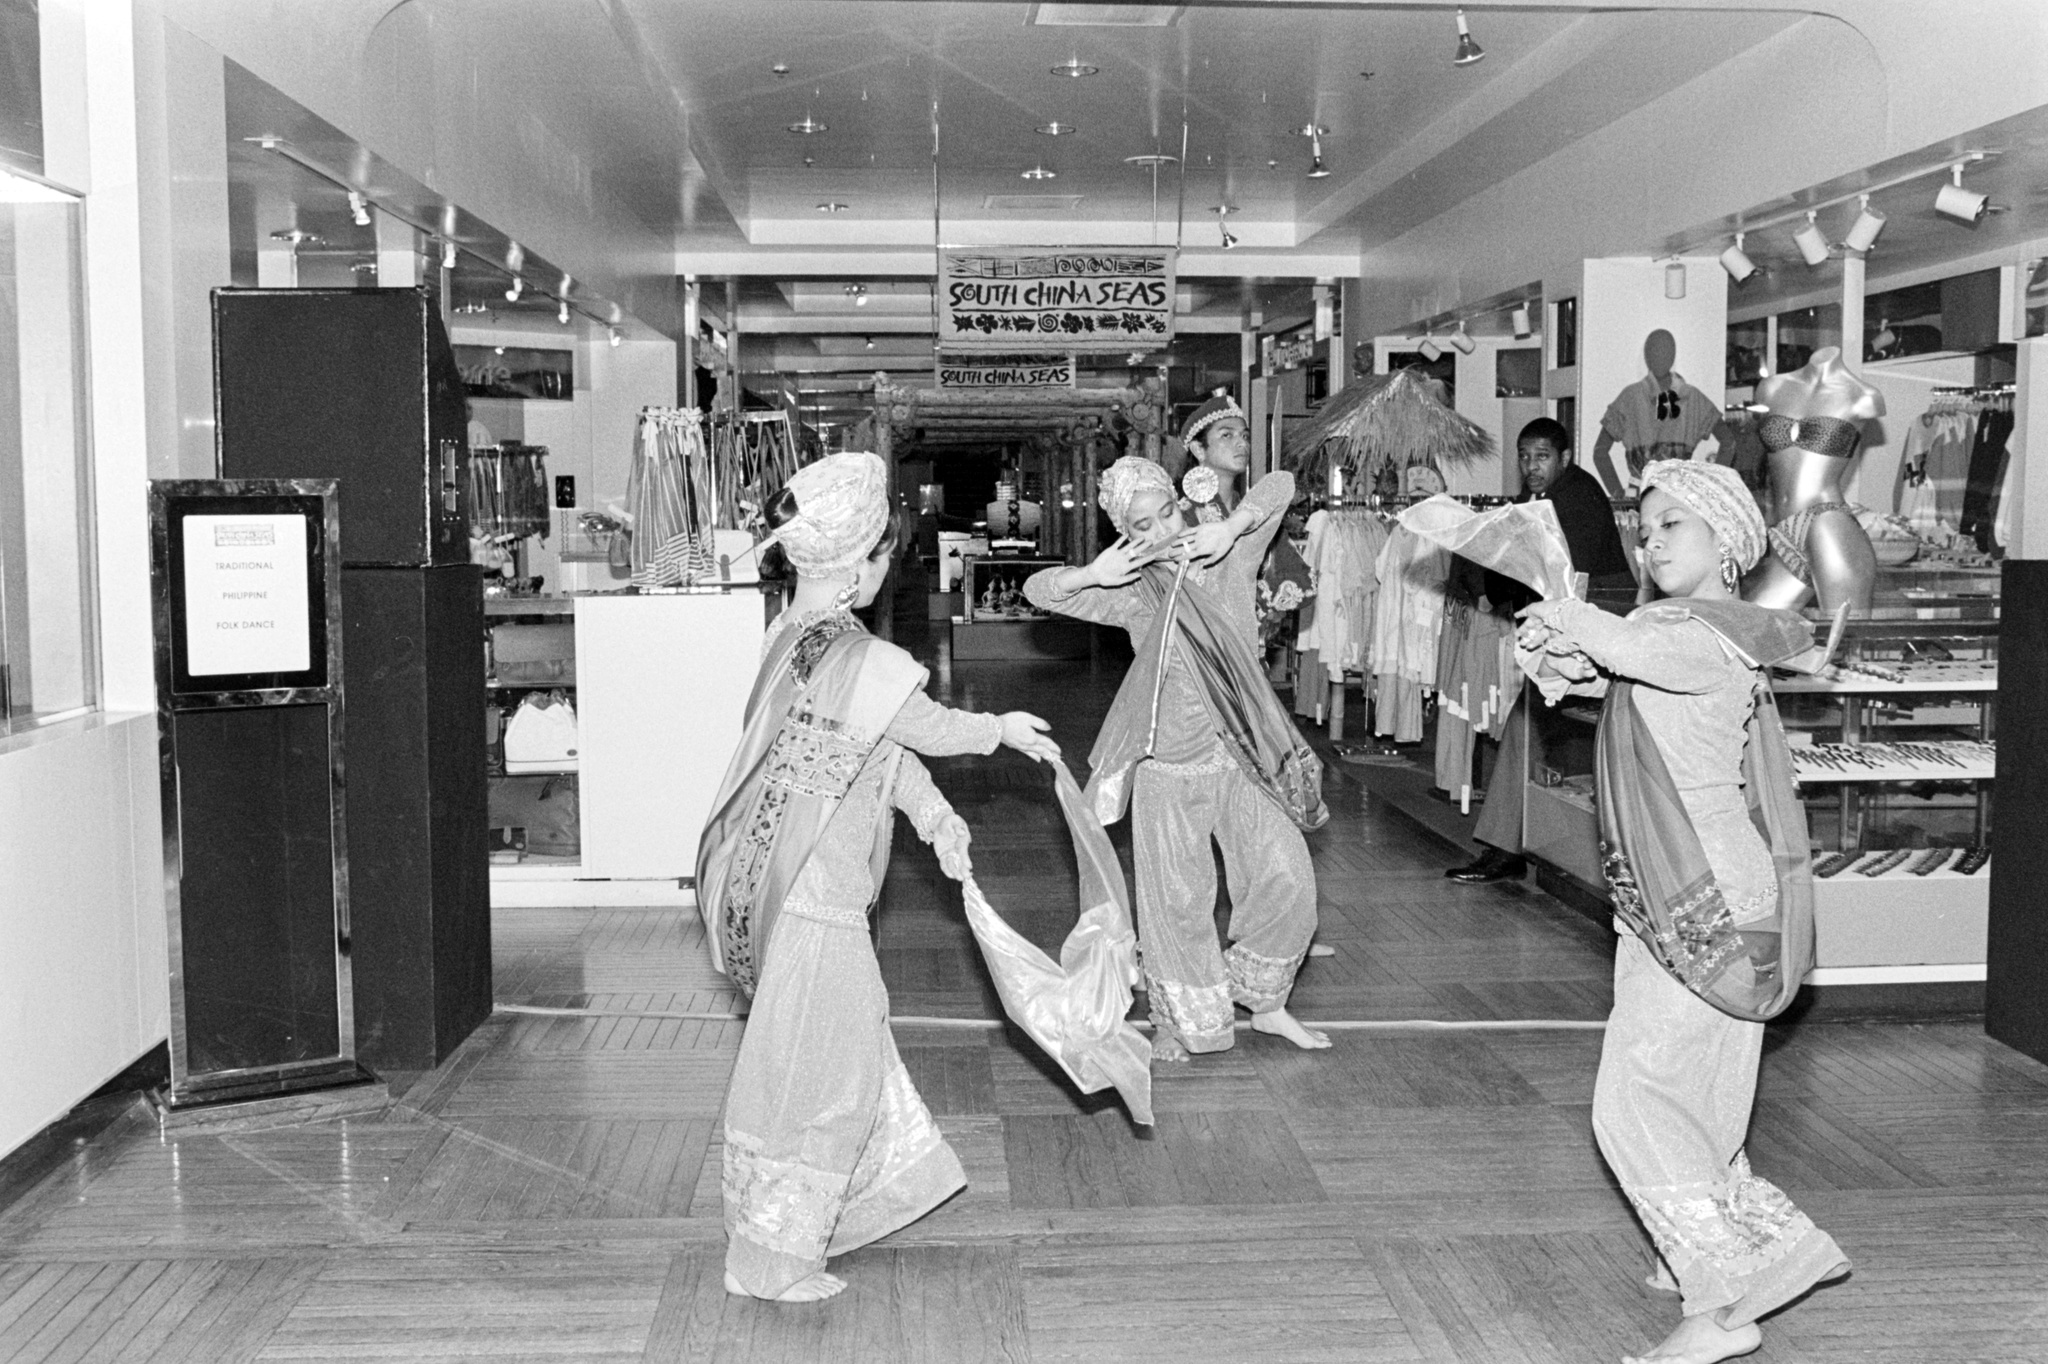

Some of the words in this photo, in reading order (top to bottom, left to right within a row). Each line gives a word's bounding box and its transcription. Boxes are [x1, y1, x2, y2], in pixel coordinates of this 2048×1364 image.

[948, 282, 1018, 307] SOUTH
[1023, 280, 1091, 307] CHINA
[1096, 281, 1167, 306] SEAS
[940, 369, 981, 385] SOUTH
[984, 368, 1026, 384] CHINA
[1028, 367, 1070, 384] SEAS
[215, 561, 274, 570] TRADITIONAL
[222, 591, 268, 600] PHILIPPINE
[216, 621, 239, 630] FOLK
[242, 620, 275, 629] DANCE
